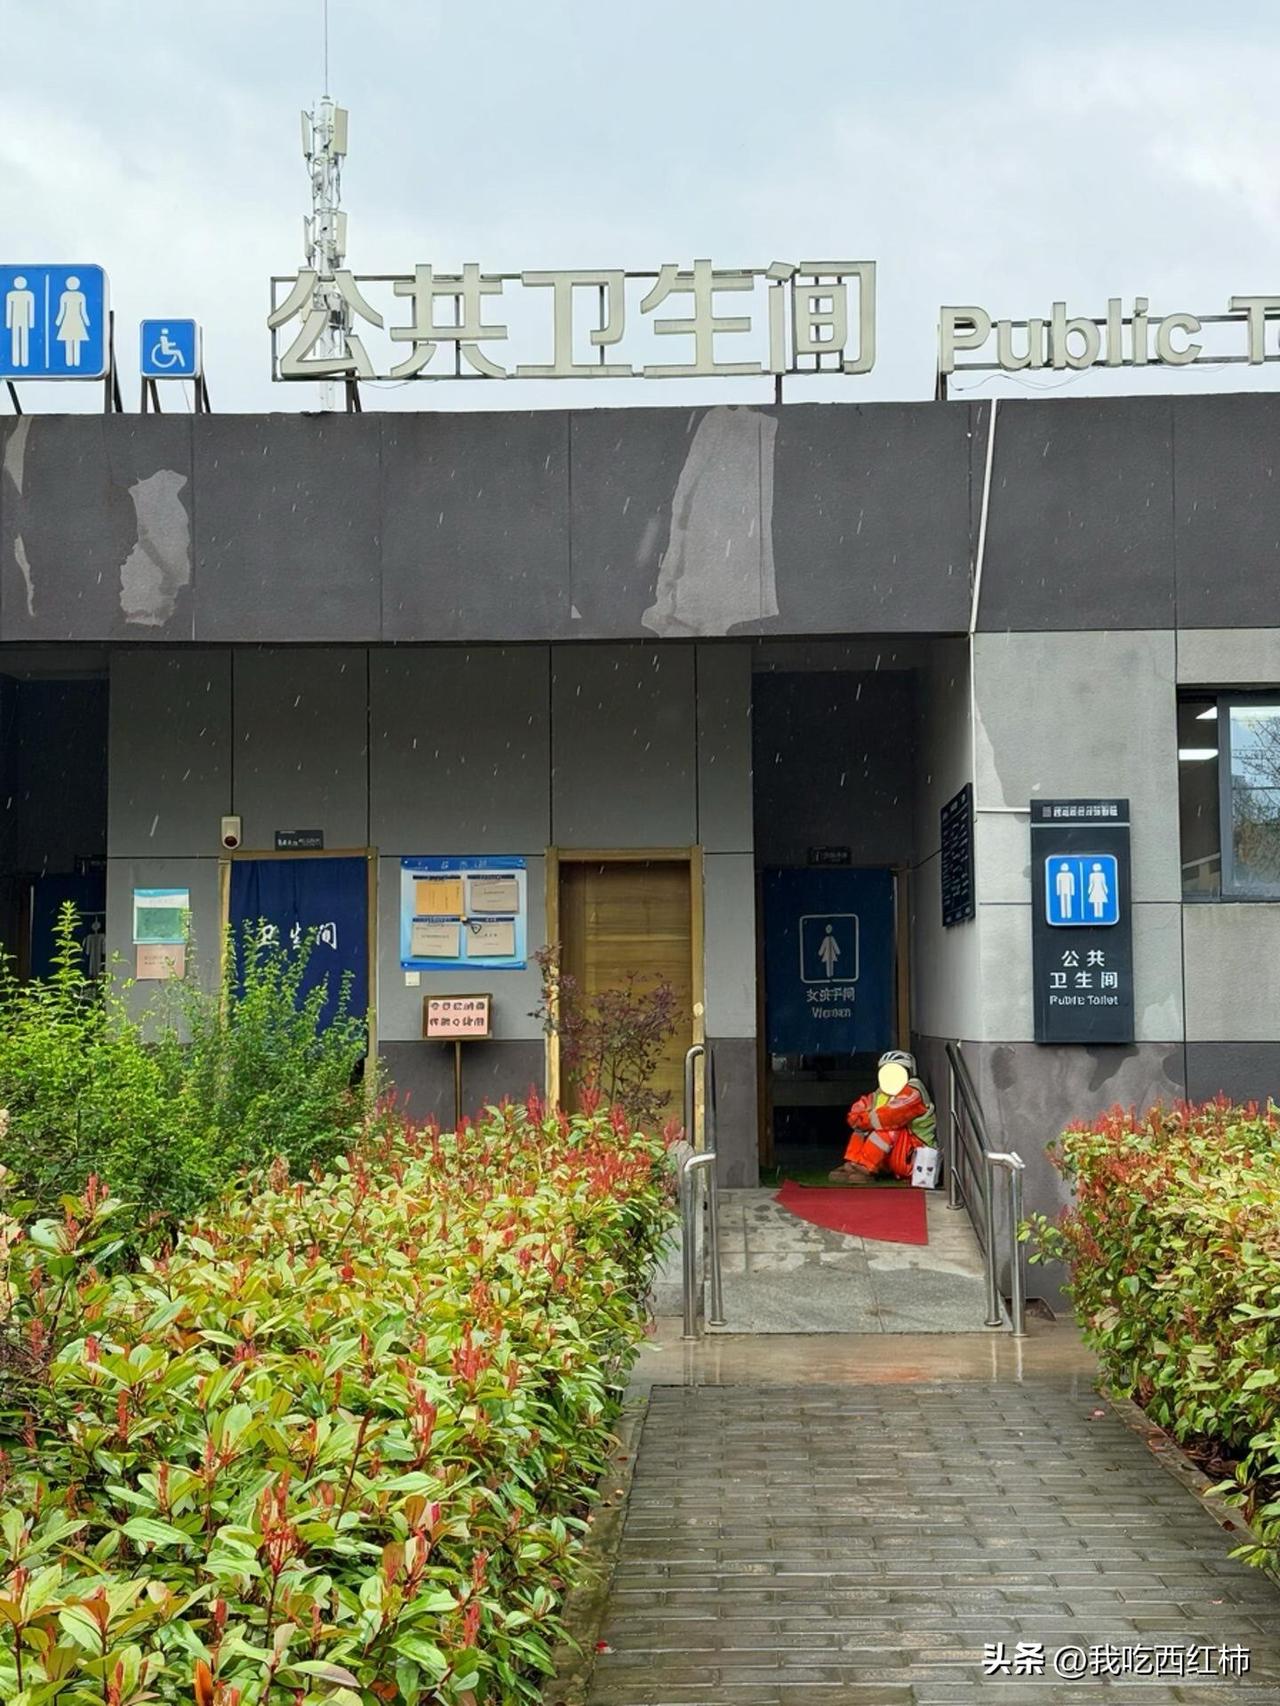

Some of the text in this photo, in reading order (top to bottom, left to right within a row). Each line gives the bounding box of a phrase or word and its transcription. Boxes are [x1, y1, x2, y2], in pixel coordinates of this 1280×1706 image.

[268, 259, 876, 379] 公共卫生间
[940, 295, 1280, 373] Public T
[1061, 949, 1105, 967] 公共
[1049, 970, 1118, 989] 卫生间
[1049, 995, 1119, 1006] Public Toilet
